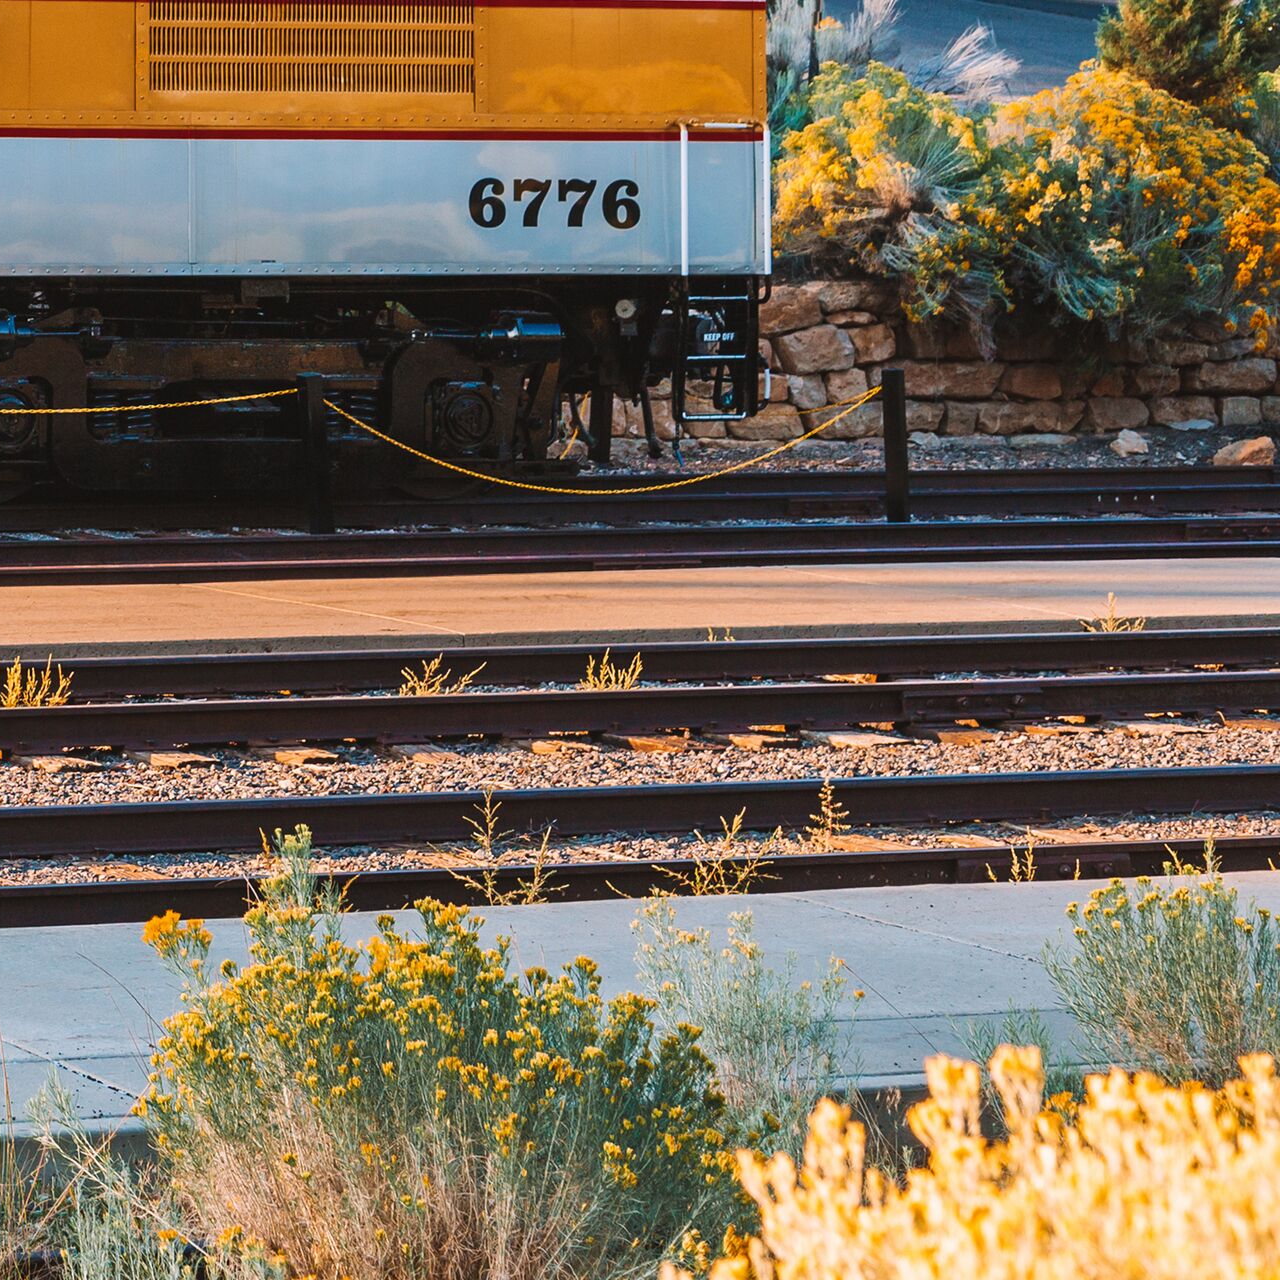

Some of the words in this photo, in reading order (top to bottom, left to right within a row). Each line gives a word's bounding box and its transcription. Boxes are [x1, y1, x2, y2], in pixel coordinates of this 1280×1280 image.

[468, 177, 641, 230] 6776
[703, 333, 721, 341] KEEP
[722, 332, 735, 341] OFF
